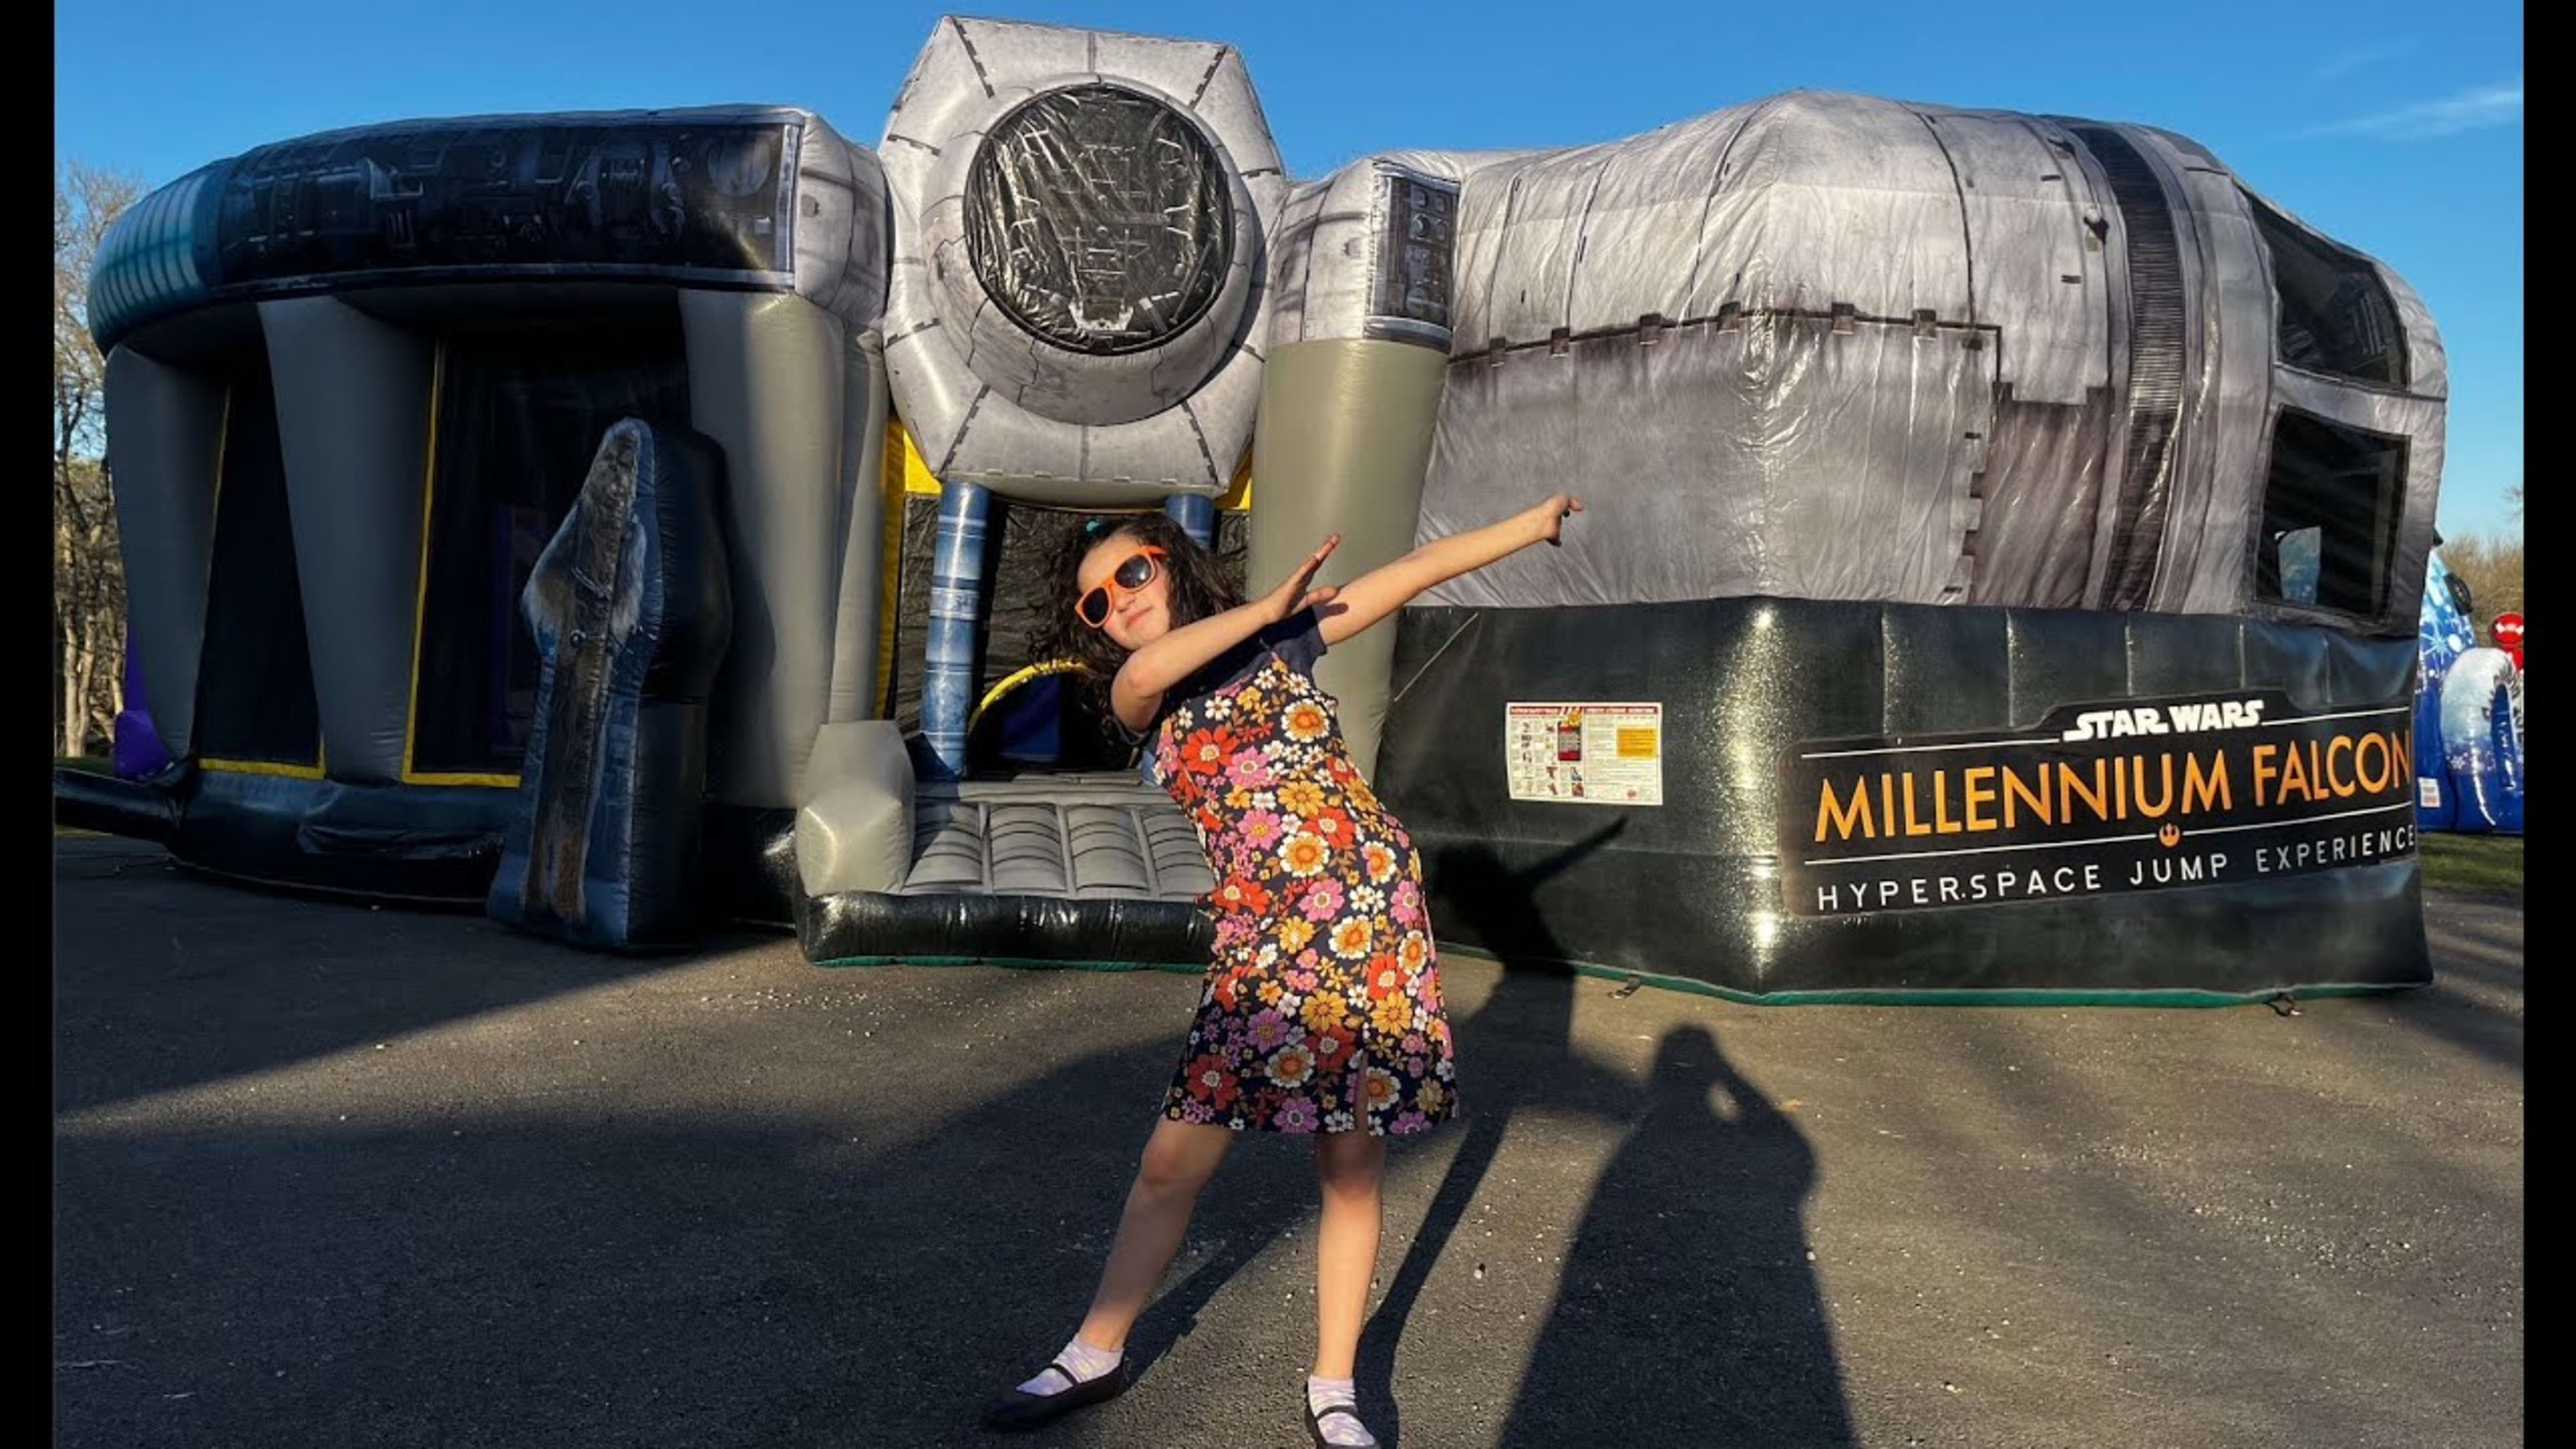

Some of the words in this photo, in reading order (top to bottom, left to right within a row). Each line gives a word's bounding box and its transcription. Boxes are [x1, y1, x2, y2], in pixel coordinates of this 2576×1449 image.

[2062, 708, 2169, 742] STAR
[2167, 699, 2265, 733] WARS
[1813, 749, 2233, 843] MILLENNIUM
[2253, 729, 2411, 806] FALCON
[1818, 864, 2102, 911] HYPERSPACE
[2129, 852, 2229, 887] JUMP
[2255, 824, 2416, 873] EXPERIENCE
